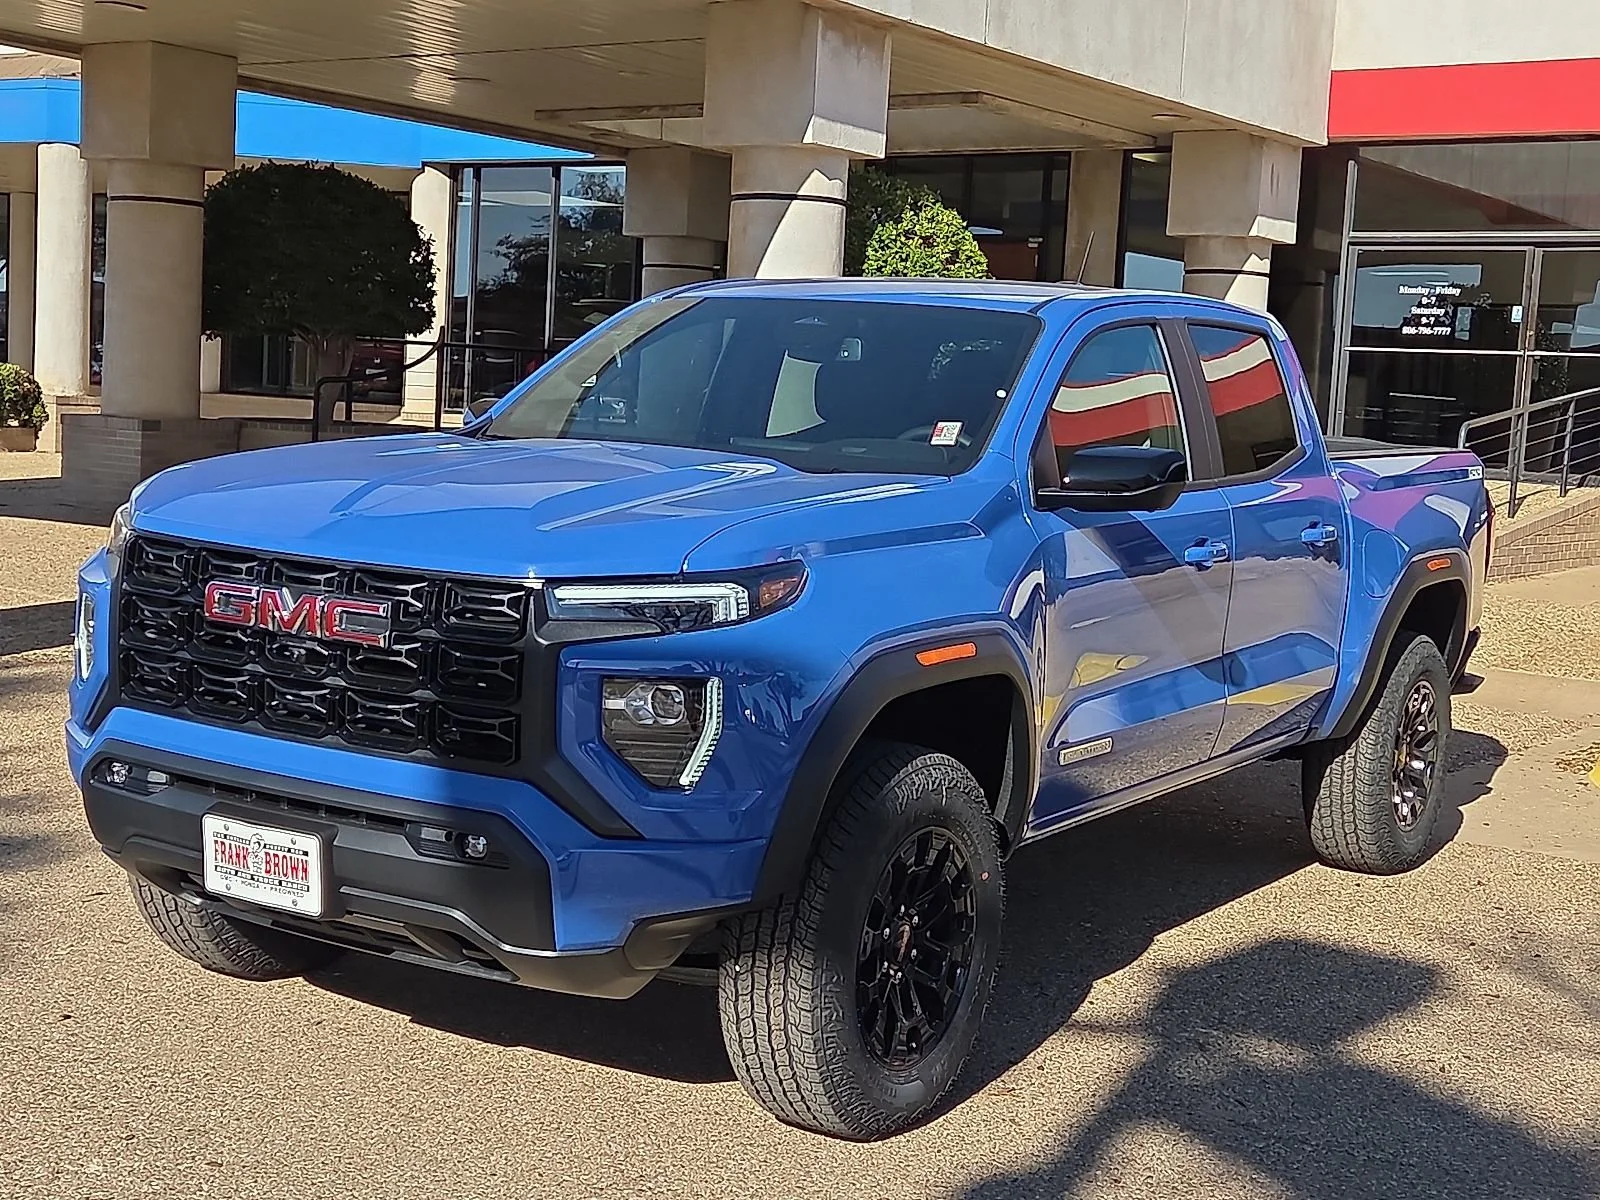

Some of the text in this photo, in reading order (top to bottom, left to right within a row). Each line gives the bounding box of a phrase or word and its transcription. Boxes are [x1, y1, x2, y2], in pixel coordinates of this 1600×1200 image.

[1399, 286, 1430, 295] Monday
[1436, 286, 1461, 296] Friday
[1411, 306, 1445, 316] Saturday
[204, 580, 392, 649] GMC
[213, 839, 251, 870] FRANK
[264, 851, 309, 882] BROWN
